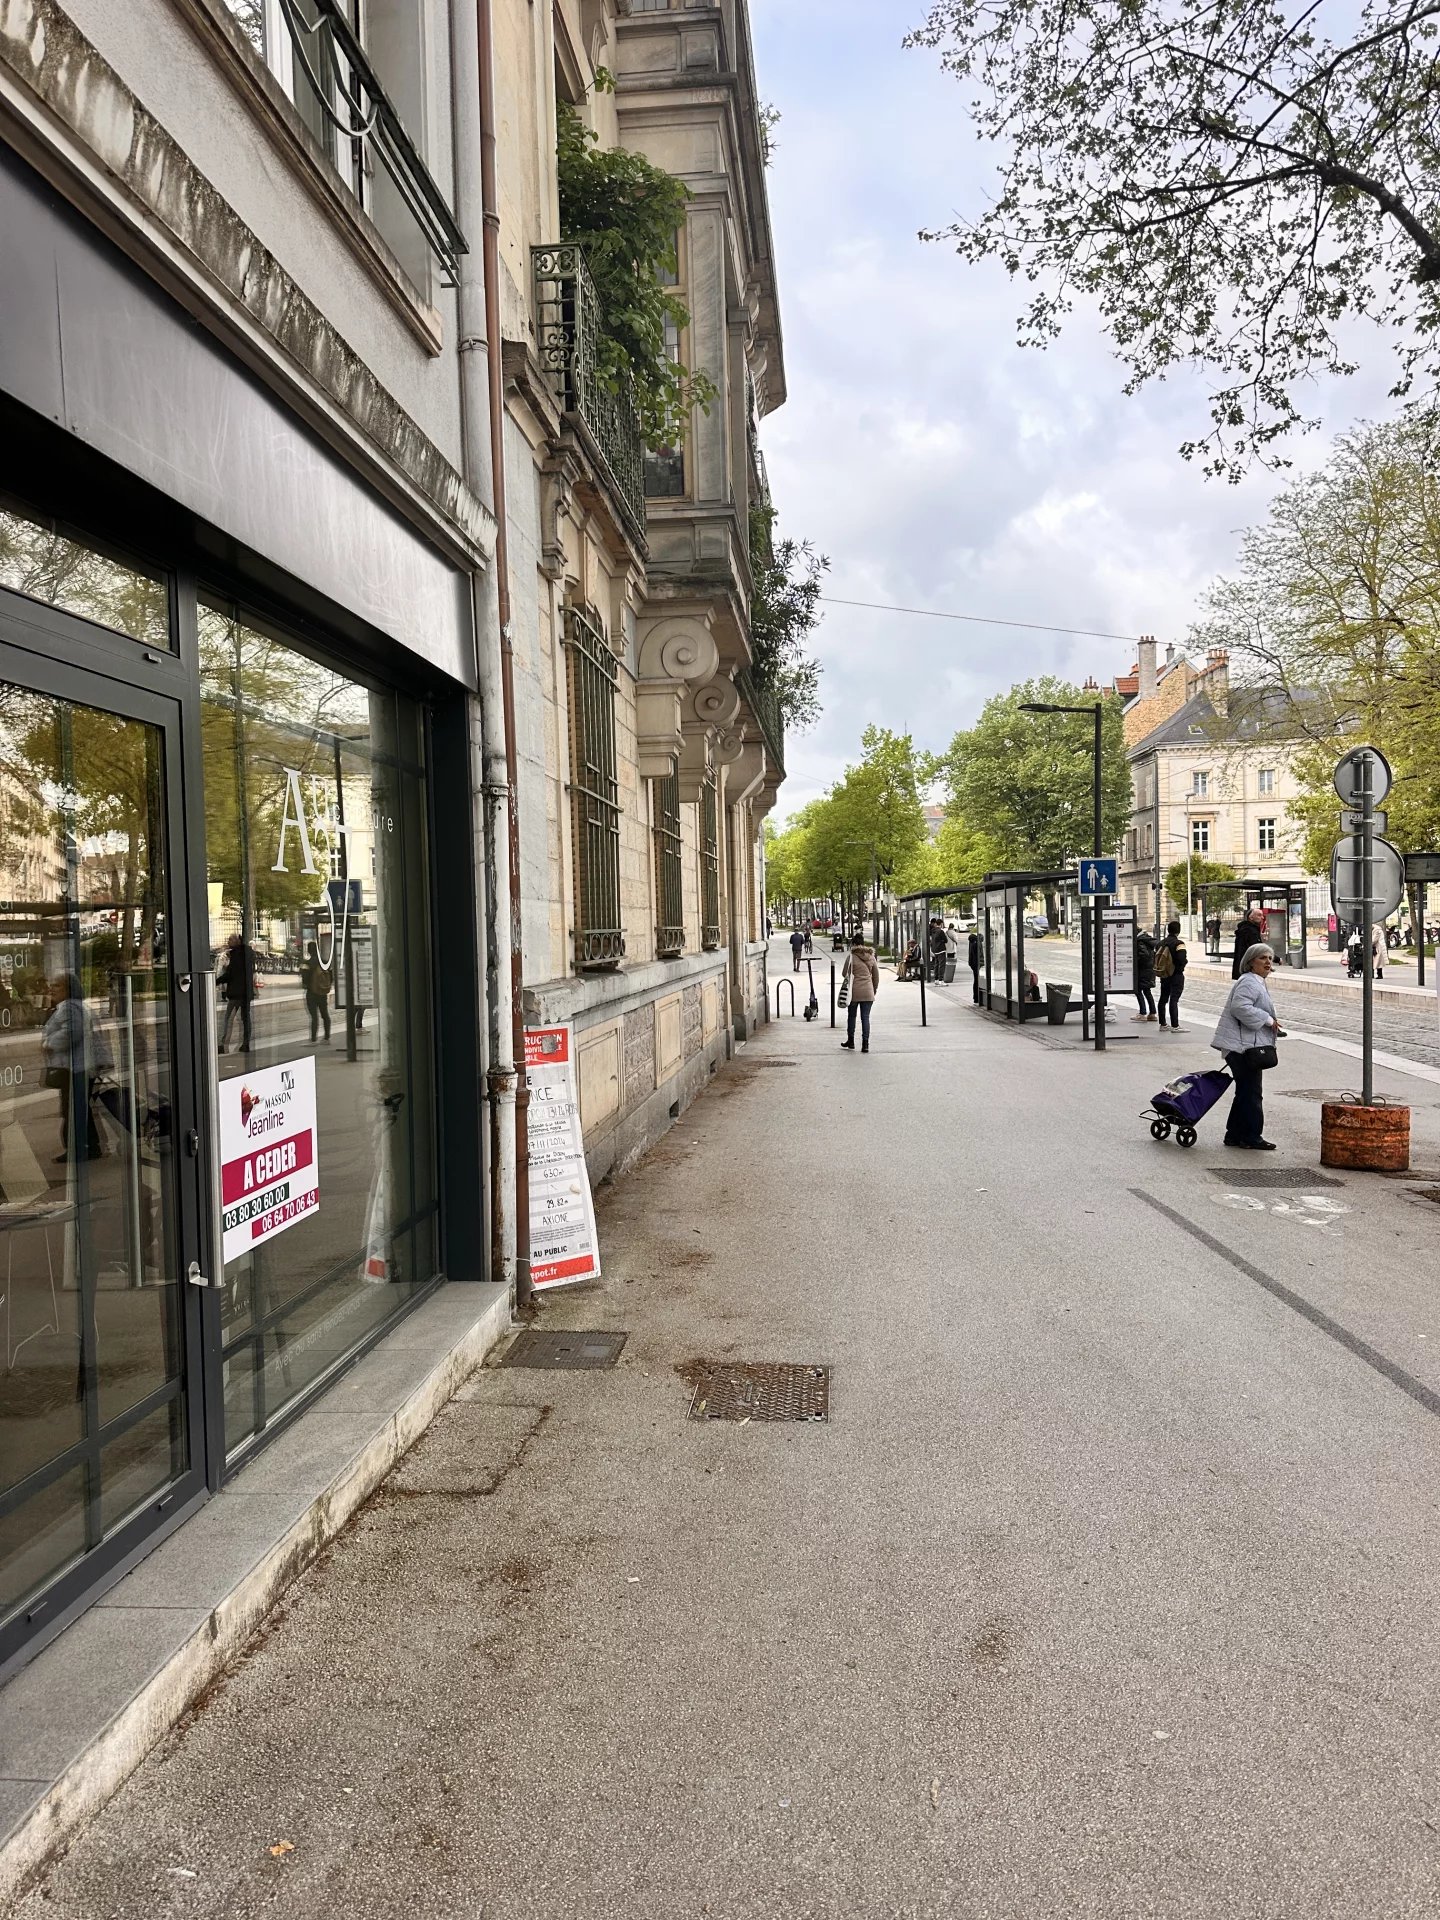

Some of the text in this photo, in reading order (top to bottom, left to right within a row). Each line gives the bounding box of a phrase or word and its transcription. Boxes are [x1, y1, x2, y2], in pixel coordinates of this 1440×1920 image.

[265, 1091, 292, 1110] MASSON
[248, 1110, 284, 1139] Jeanline
[244, 1140, 297, 1191] A CEDER
[226, 1185, 286, 1229] 03 80 30 60 00
[262, 1190, 316, 1232] 06 64 70 06 43
[533, 1250, 543, 1258] AU
[544, 1245, 568, 1256] PUBLIC
